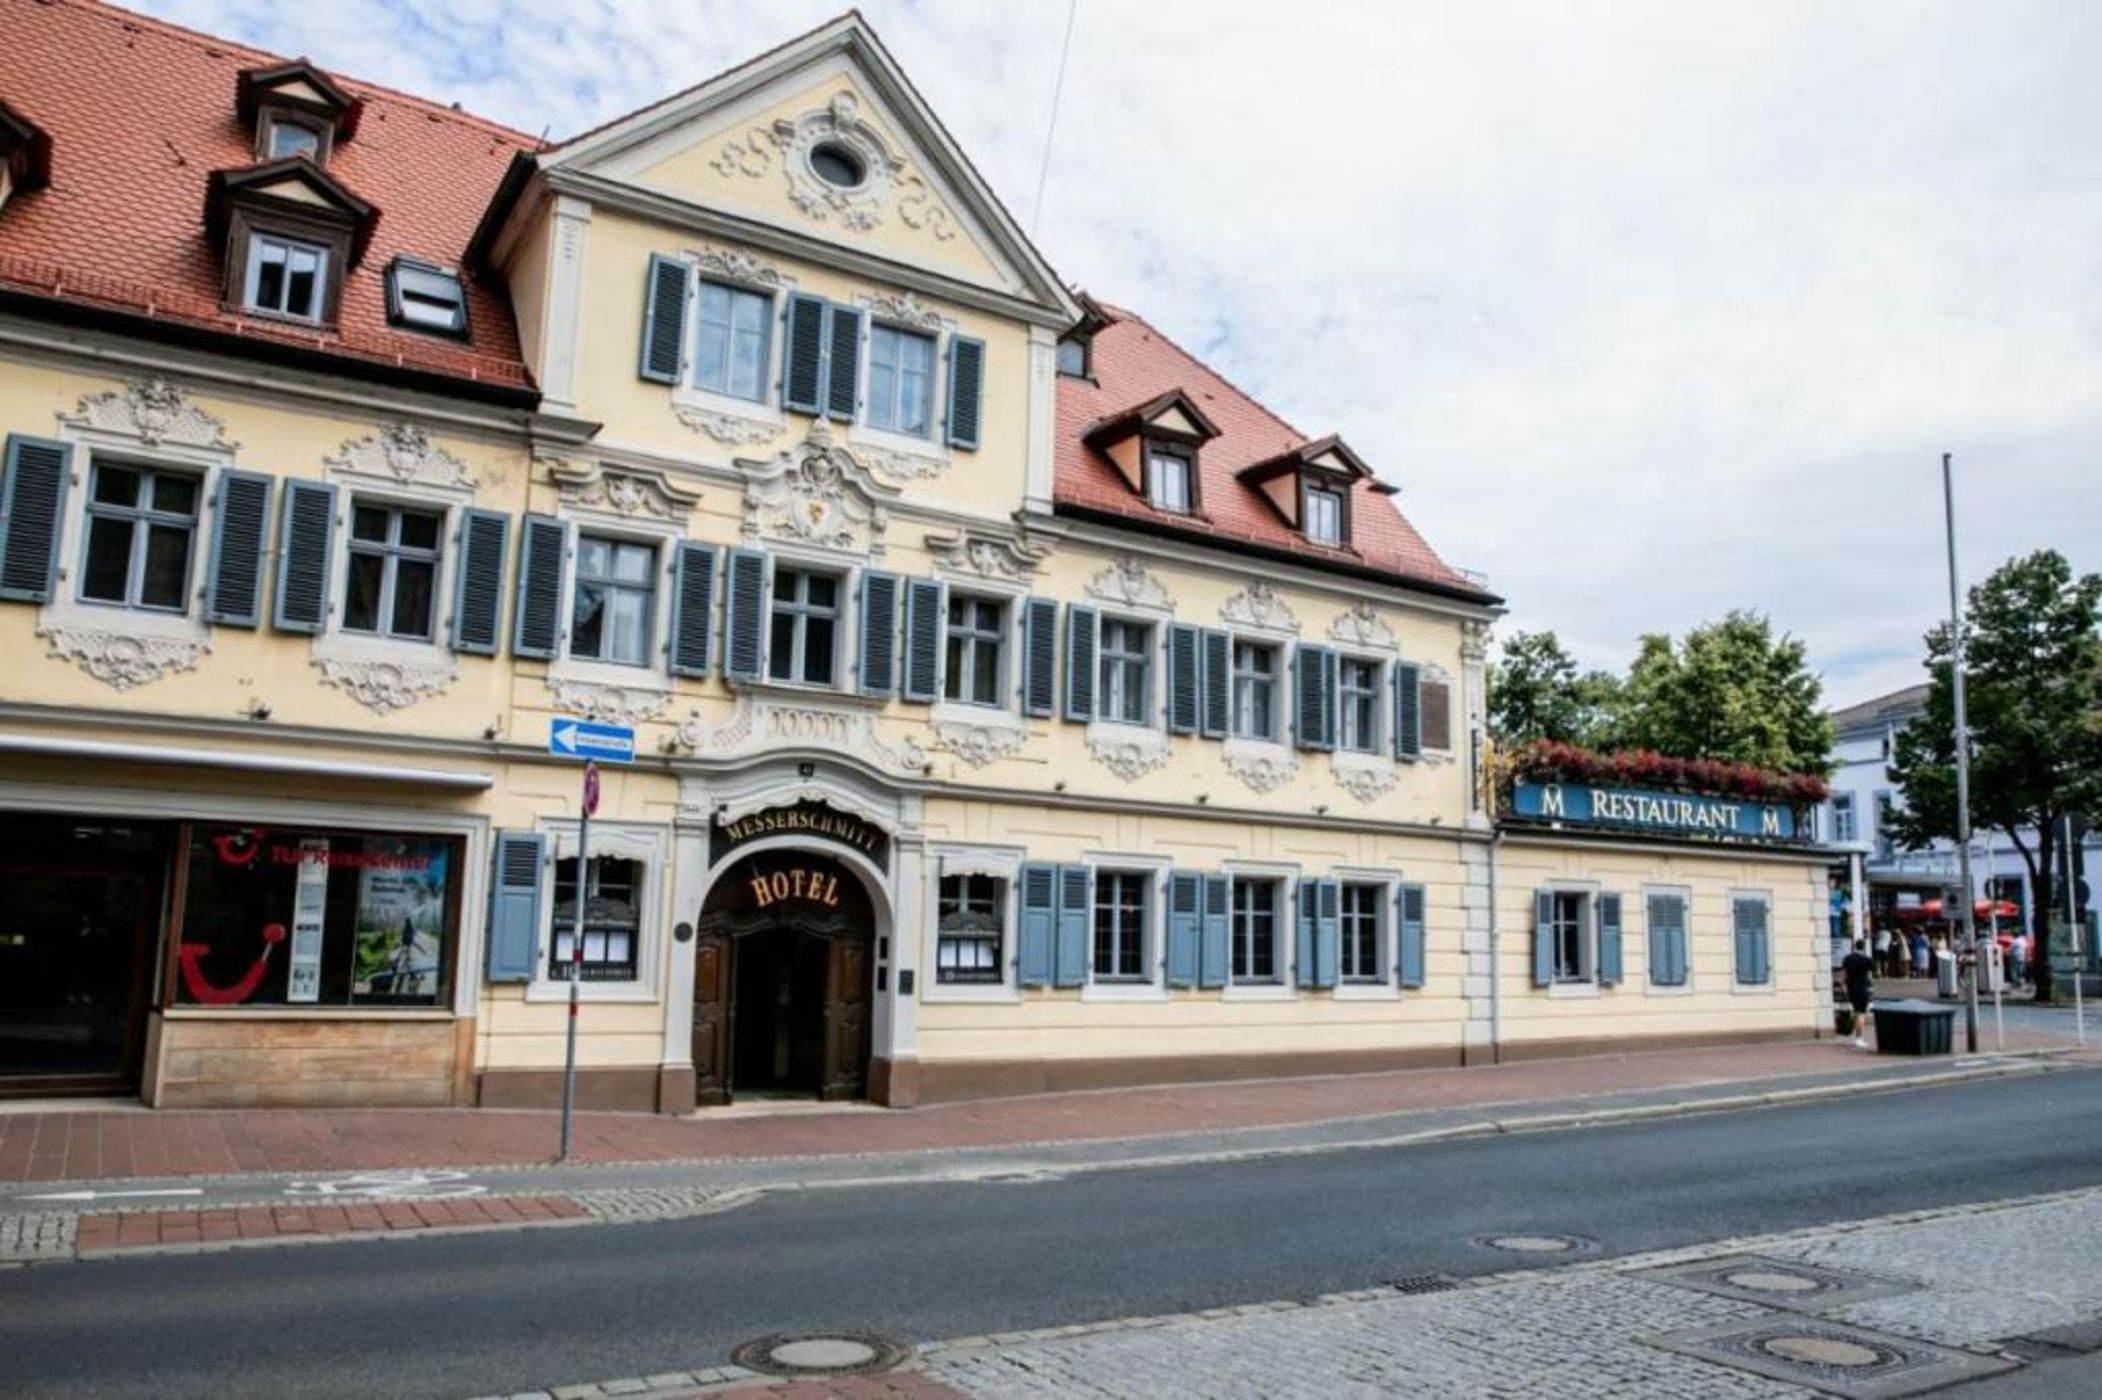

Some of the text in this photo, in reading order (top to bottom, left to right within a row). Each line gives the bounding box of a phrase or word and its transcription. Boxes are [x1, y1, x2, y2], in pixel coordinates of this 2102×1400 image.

[1591, 790, 1741, 828] RESTAURANT
[726, 810, 877, 850] MESSERSCHMITT
[752, 869, 839, 907] HOTEL
